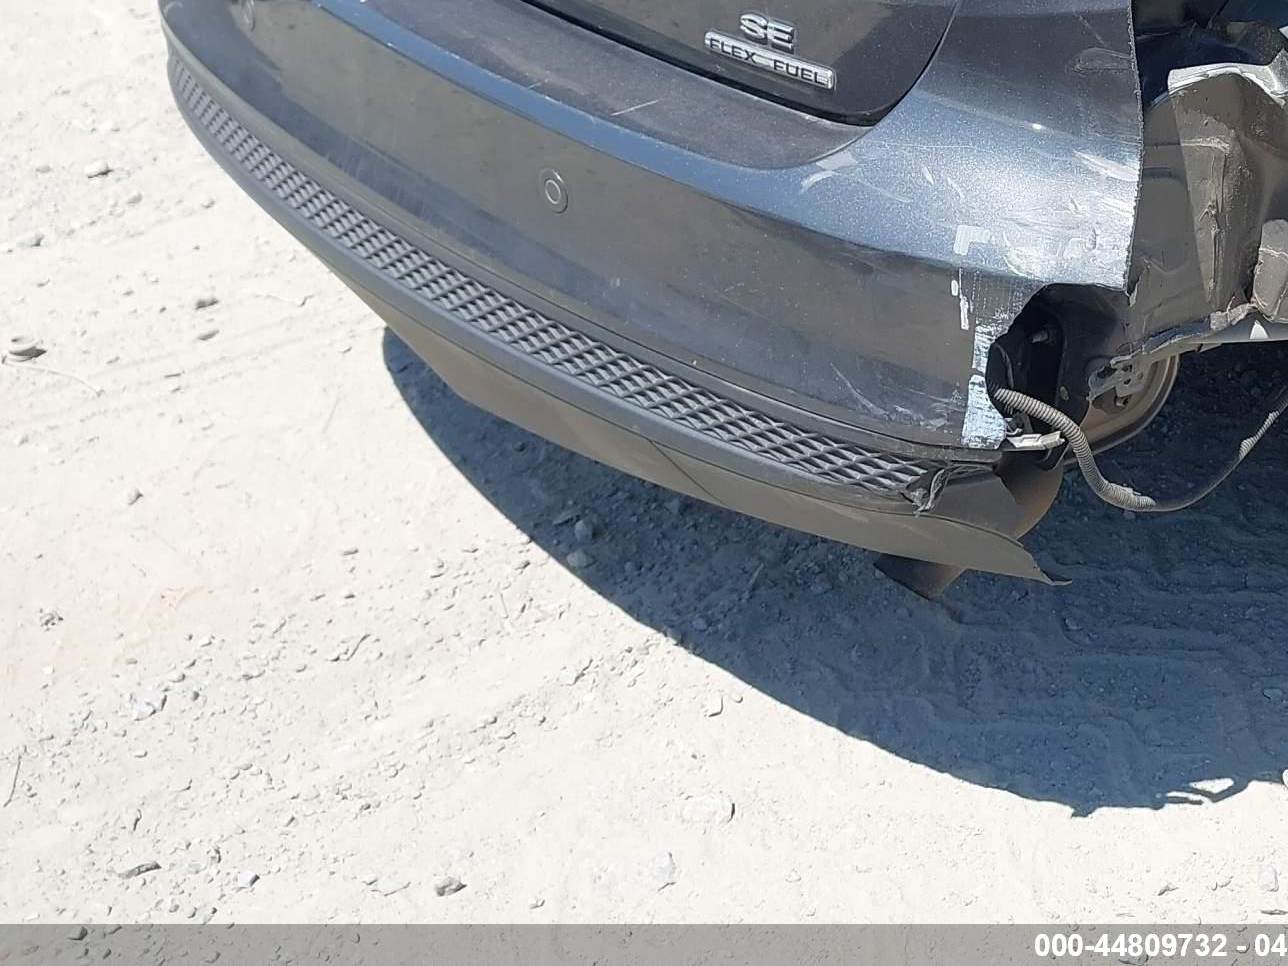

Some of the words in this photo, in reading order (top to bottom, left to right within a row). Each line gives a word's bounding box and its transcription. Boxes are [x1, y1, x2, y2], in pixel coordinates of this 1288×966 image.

[739, 13, 795, 50] SE
[708, 37, 758, 64] FLEX
[772, 58, 830, 86] FUEL
